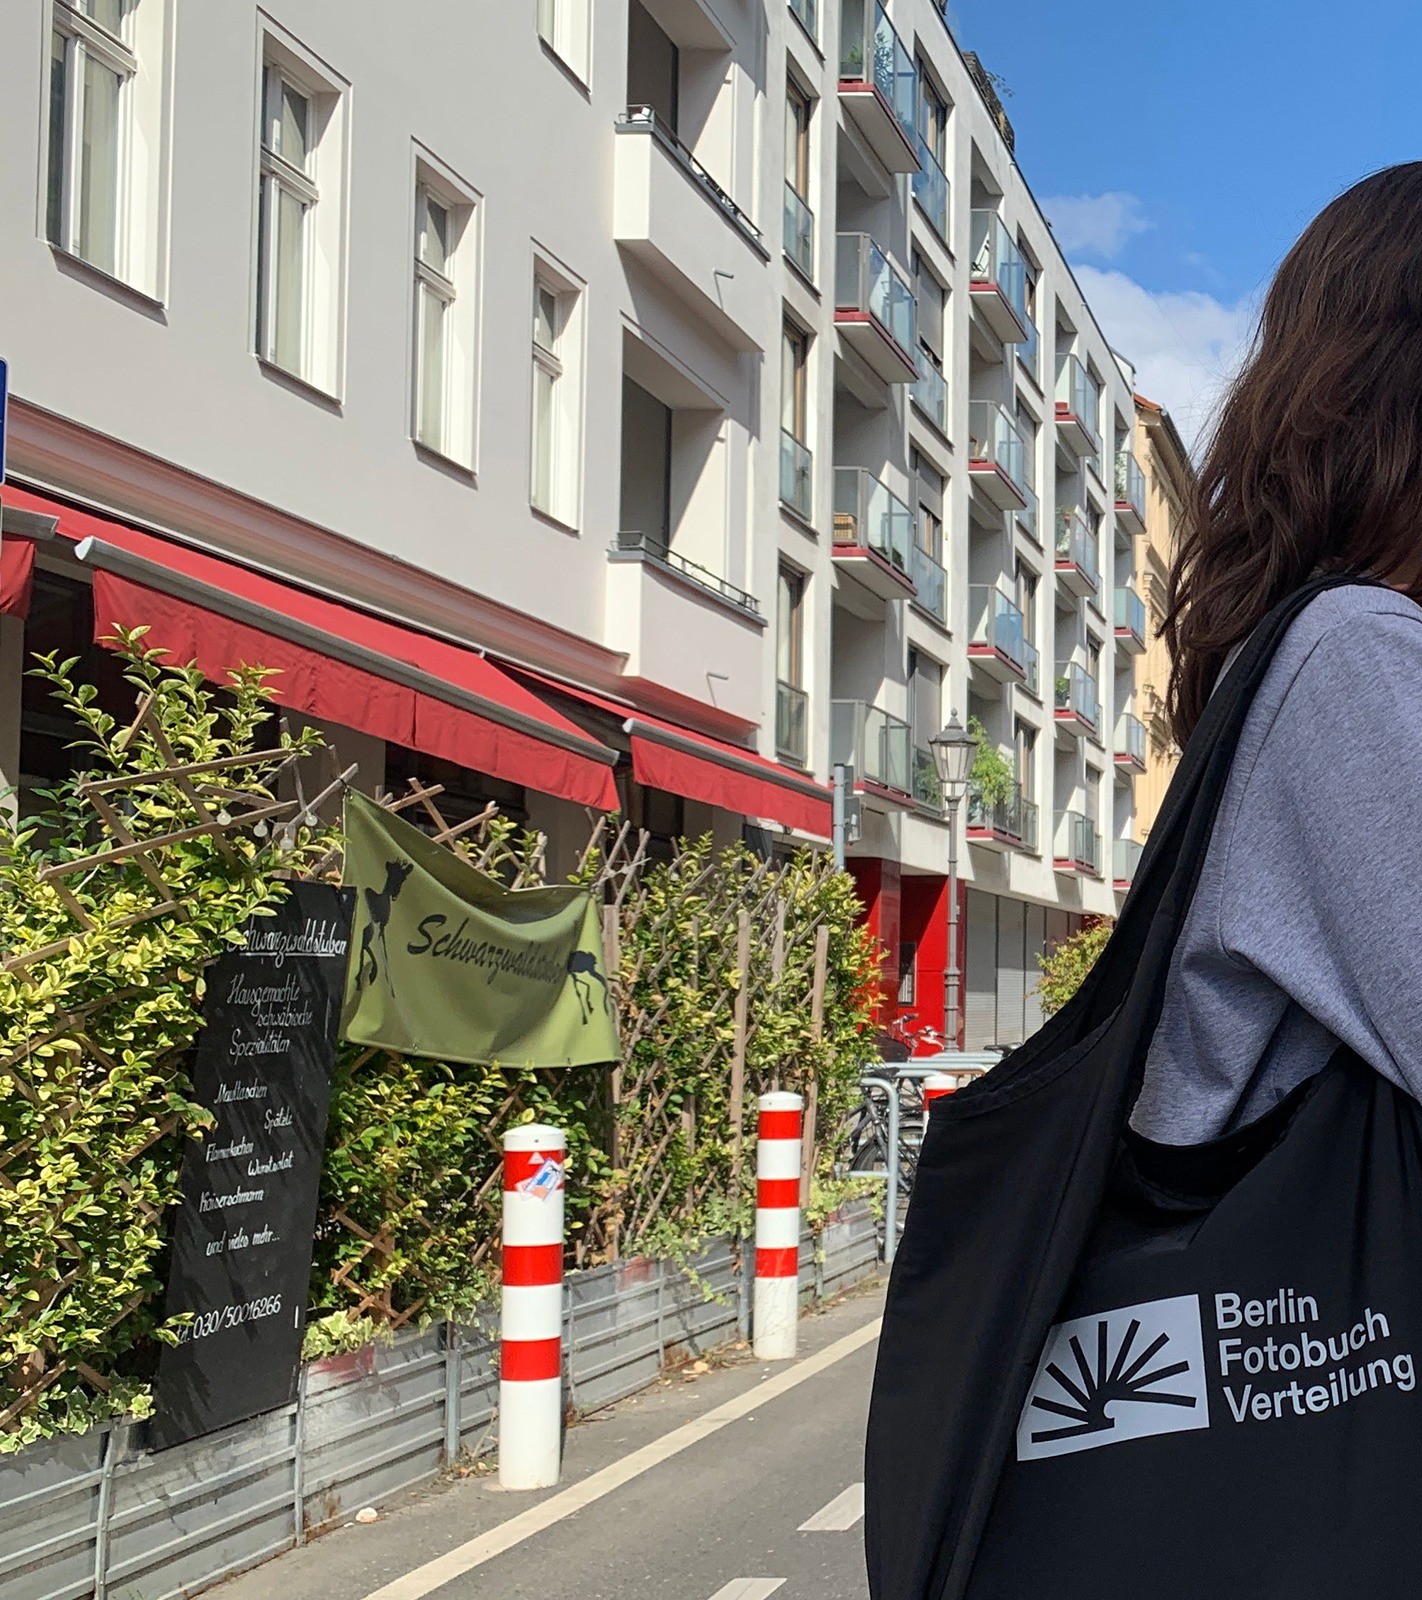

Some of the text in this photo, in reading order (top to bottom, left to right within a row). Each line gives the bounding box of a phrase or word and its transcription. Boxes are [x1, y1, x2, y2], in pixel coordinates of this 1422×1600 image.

[227, 973, 299, 1016] Hausgemachte
[214, 1078, 267, 1104] Maultaschen
[206, 1231, 226, 1256] und
[228, 1227, 249, 1250] vieles
[193, 1294, 281, 1339] 030/50016266
[1214, 1288, 1319, 1331] Berlin
[1218, 1307, 1391, 1377] Fotobuch
[1222, 1353, 1417, 1424] Verteilung
